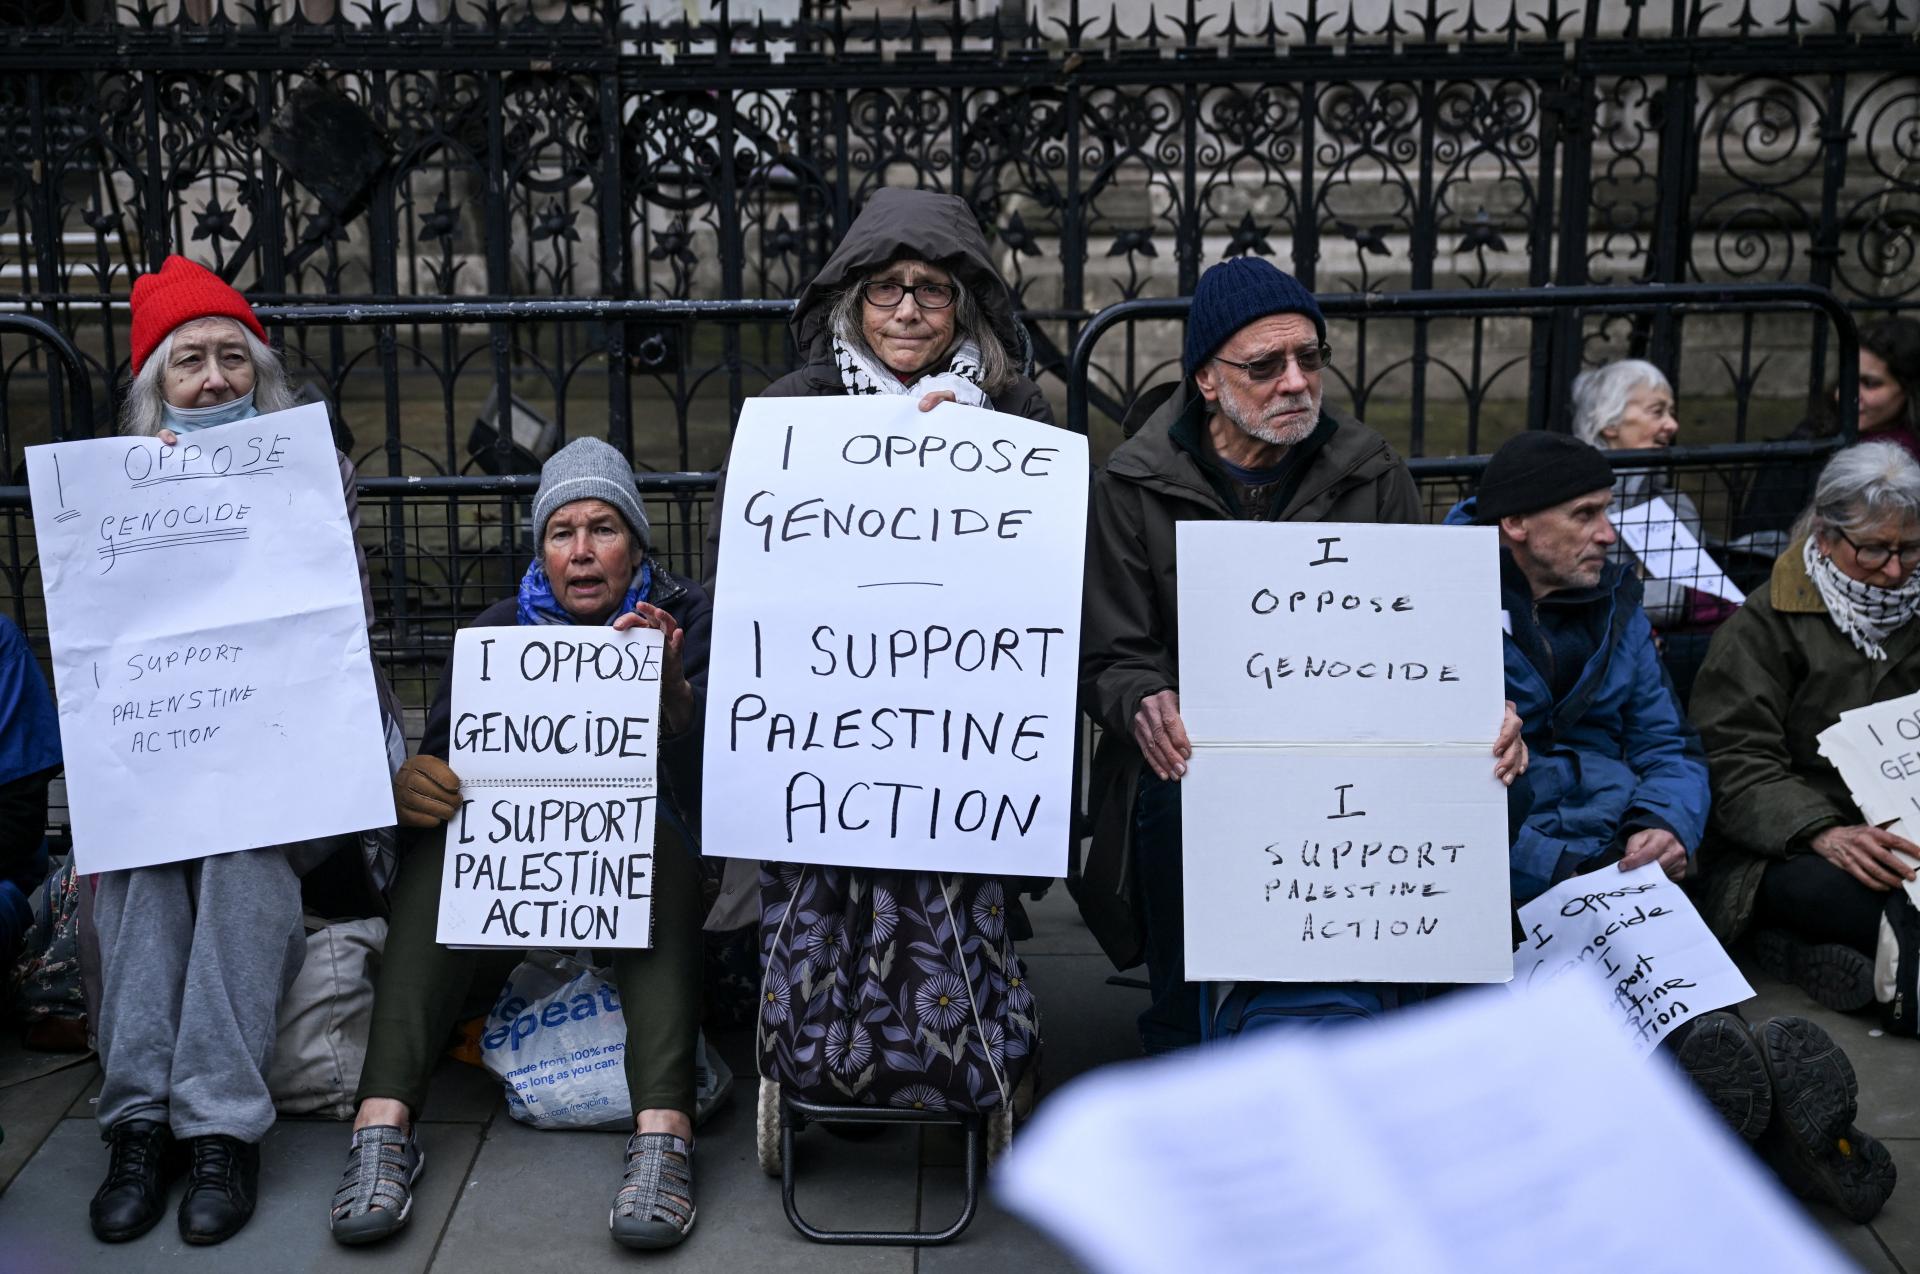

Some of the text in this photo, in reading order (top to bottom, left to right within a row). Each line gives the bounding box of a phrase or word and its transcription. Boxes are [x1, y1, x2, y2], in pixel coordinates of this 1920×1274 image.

[124, 433, 291, 480] OPPOSE
[782, 425, 1060, 477] I OPPOSE
[100, 502, 252, 575] GENOCIDE
[743, 489, 1033, 553] GENOCIDE
[1308, 536, 1349, 567] I
[1250, 588, 1415, 616] OPPOSE
[127, 643, 244, 681] SUPPORT
[480, 638, 663, 683] I OPPOSE
[753, 620, 1064, 680] I SUPPORT
[1246, 652, 1461, 690] GENOCIDE
[112, 685, 257, 725] PALENSTINE
[131, 725, 221, 753] ACTION
[730, 693, 1049, 762] PALESTINE
[1880, 751, 1920, 780] GE
[459, 795, 657, 845] I SUPPORT
[785, 771, 1042, 843] ACTION
[1326, 783, 1367, 820] I
[1264, 839, 1466, 871] SUPPORT
[1264, 878, 1449, 903] PALESTINE
[1301, 912, 1439, 942] ACTION
[1527, 905, 1674, 986] nocide
[1531, 923, 1554, 950] I
[506, 1064, 537, 1079] made
[540, 1057, 567, 1070] from
[571, 1046, 601, 1062] 100%
[515, 1081, 528, 1091] as
[530, 1073, 555, 1085] long
[556, 1070, 569, 1080] as
[571, 1064, 592, 1079] you
